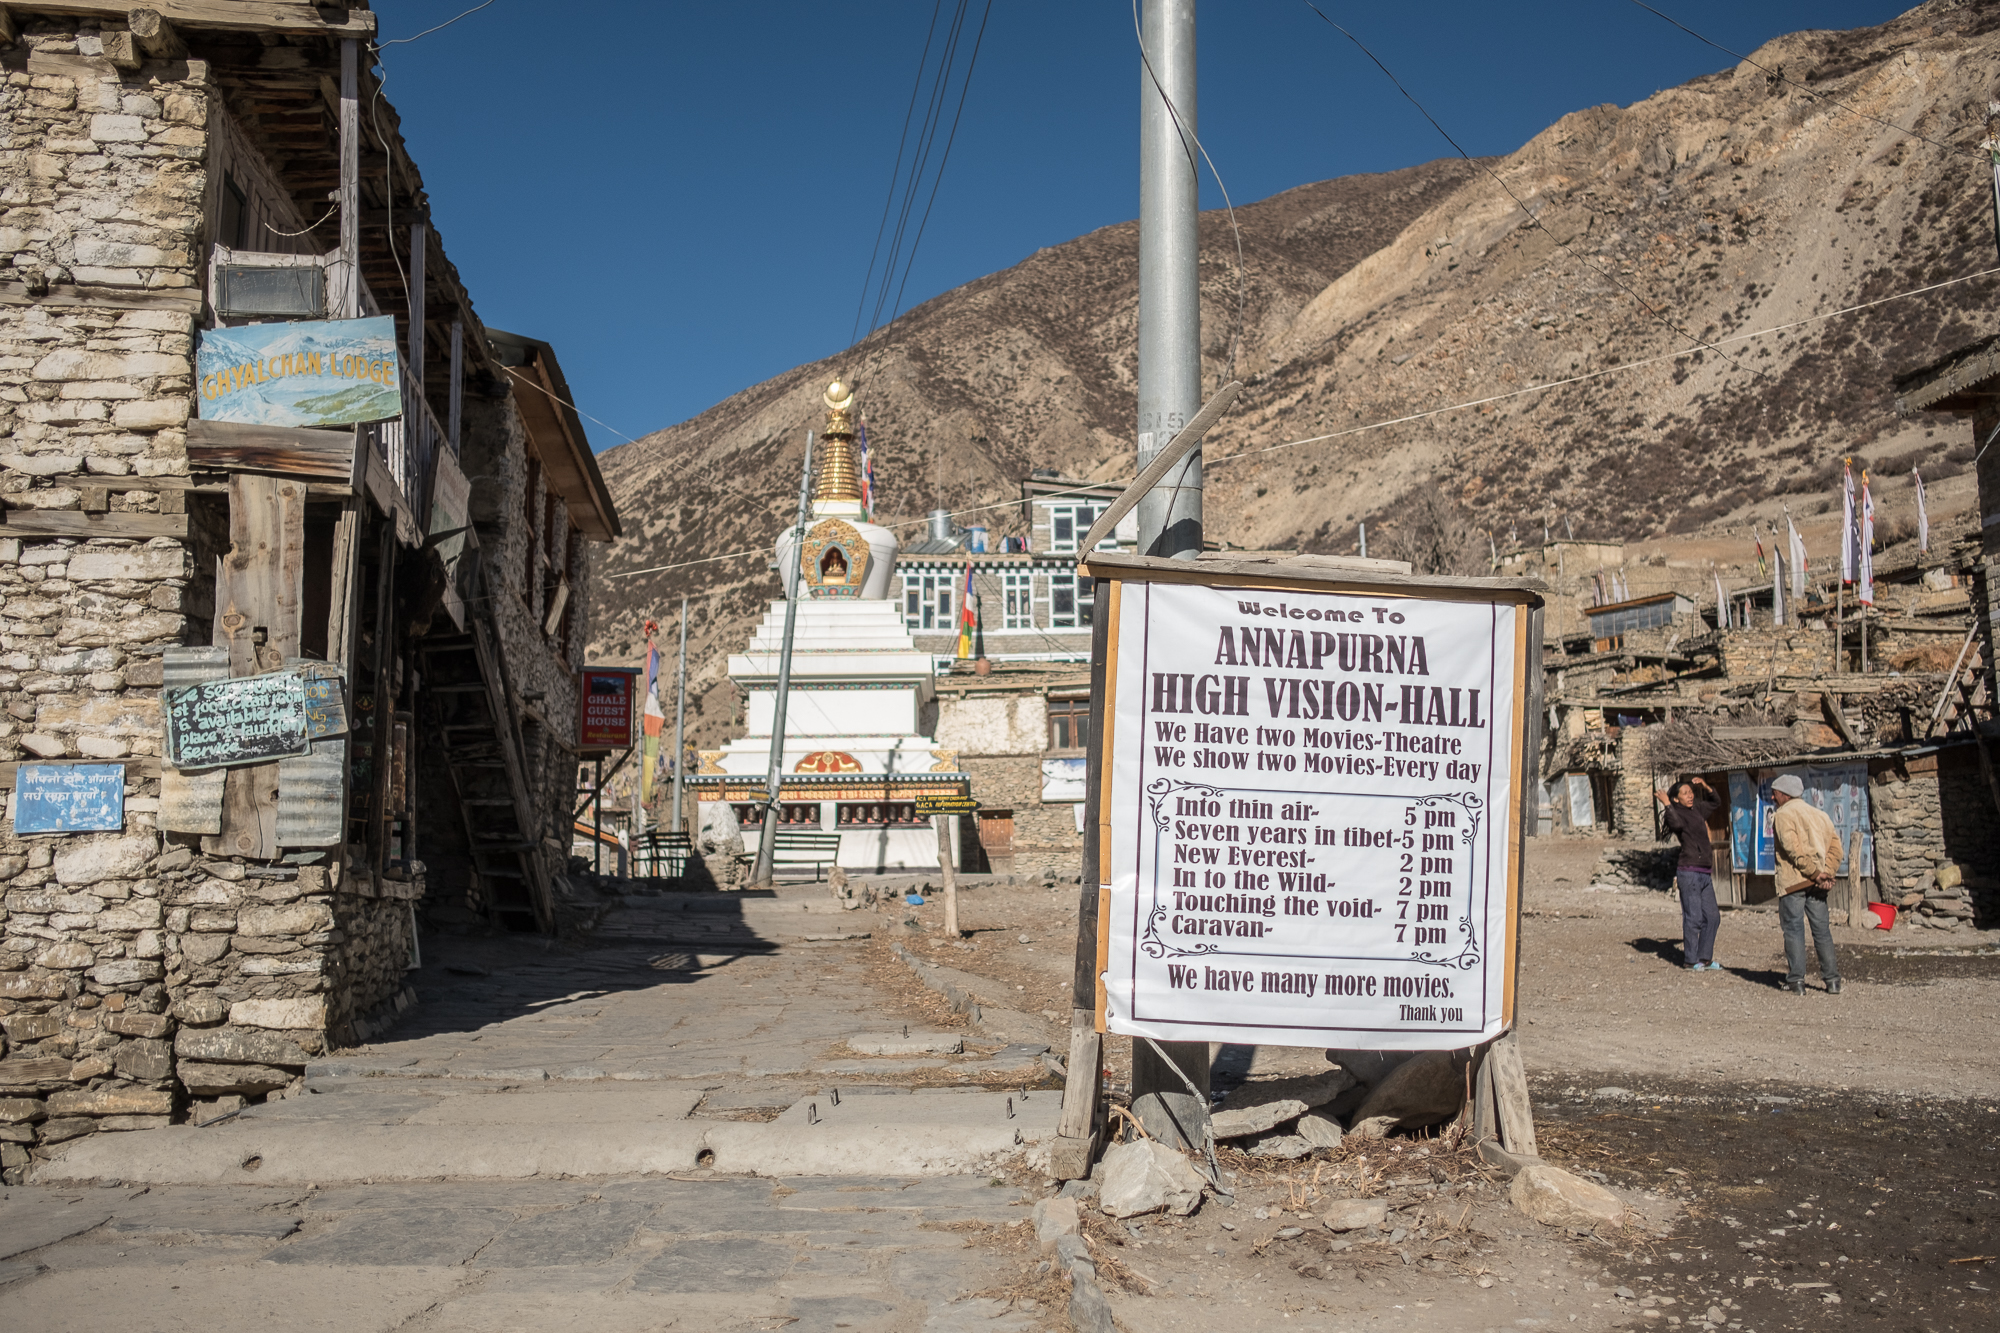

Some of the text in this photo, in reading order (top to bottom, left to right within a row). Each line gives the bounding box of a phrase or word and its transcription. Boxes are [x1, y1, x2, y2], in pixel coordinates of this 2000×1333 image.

[202, 352, 395, 401] GHYALCHAN LODGE
[1238, 601, 1405, 624] Welcome To
[1215, 626, 1429, 675] ANNAPURNA
[588, 695, 627, 705] GHALE
[588, 706, 626, 716] GUEST
[1151, 673, 1485, 728] HIGH VISION-HALL
[198, 709, 265, 730] available
[587, 717, 626, 727] HOUSE
[1155, 722, 1186, 742] We
[1194, 723, 1248, 744] Have
[1257, 726, 1295, 746] two
[180, 731, 218, 750] place
[181, 742, 240, 759] service
[1154, 746, 1185, 767] We
[1194, 748, 1249, 769] show
[1258, 751, 1296, 771] two
[1446, 760, 1481, 783] day
[1176, 797, 1455, 829] Into thin air- 5 pm
[1176, 820, 1239, 841] Seven
[1247, 826, 1306, 845] years
[1315, 826, 1335, 845] in
[1422, 834, 1453, 852] pm
[1174, 844, 1452, 875] New Everest- 2 pm
[1173, 868, 1451, 899] In to the Wild- 2 pm
[1175, 892, 1448, 922] Touching the void- 7 pm
[1172, 915, 1446, 946] Caravan- 7 pm
[1168, 964, 1453, 998] We have many more movies.
[1400, 1005, 1462, 1023] Thank you
